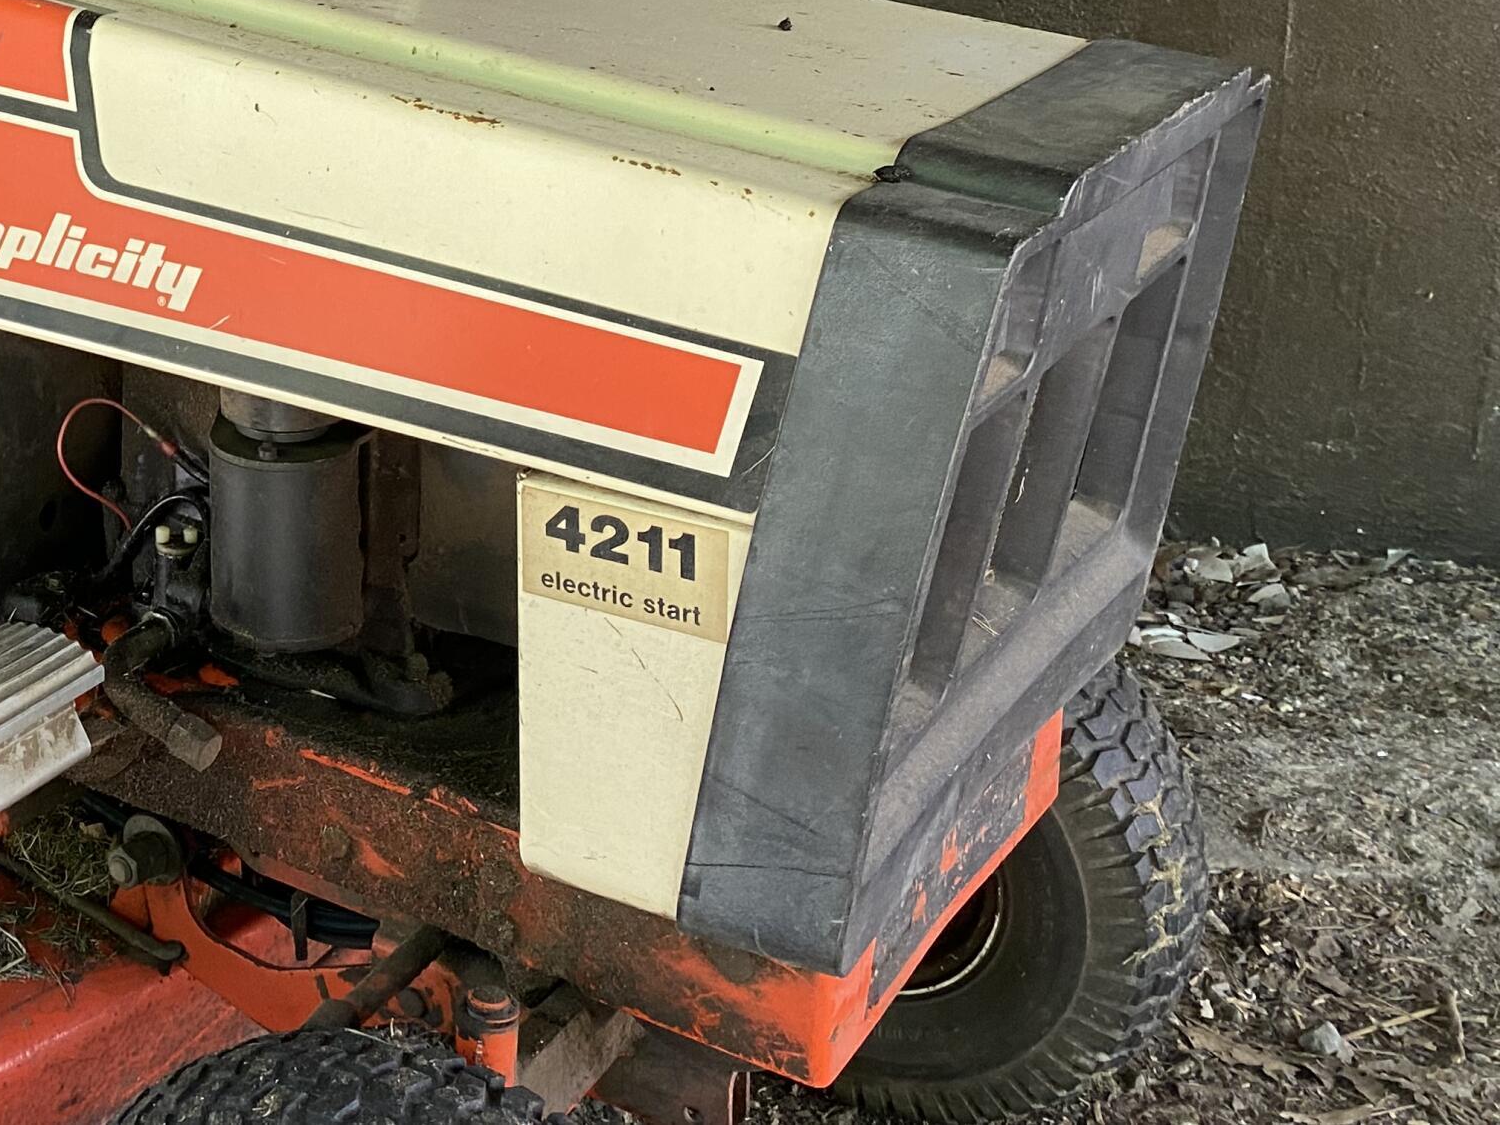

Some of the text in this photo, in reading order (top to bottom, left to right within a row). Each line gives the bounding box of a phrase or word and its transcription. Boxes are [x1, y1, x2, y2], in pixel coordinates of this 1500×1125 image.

[545, 505, 695, 581] 4211
[541, 571, 700, 626] electric start
